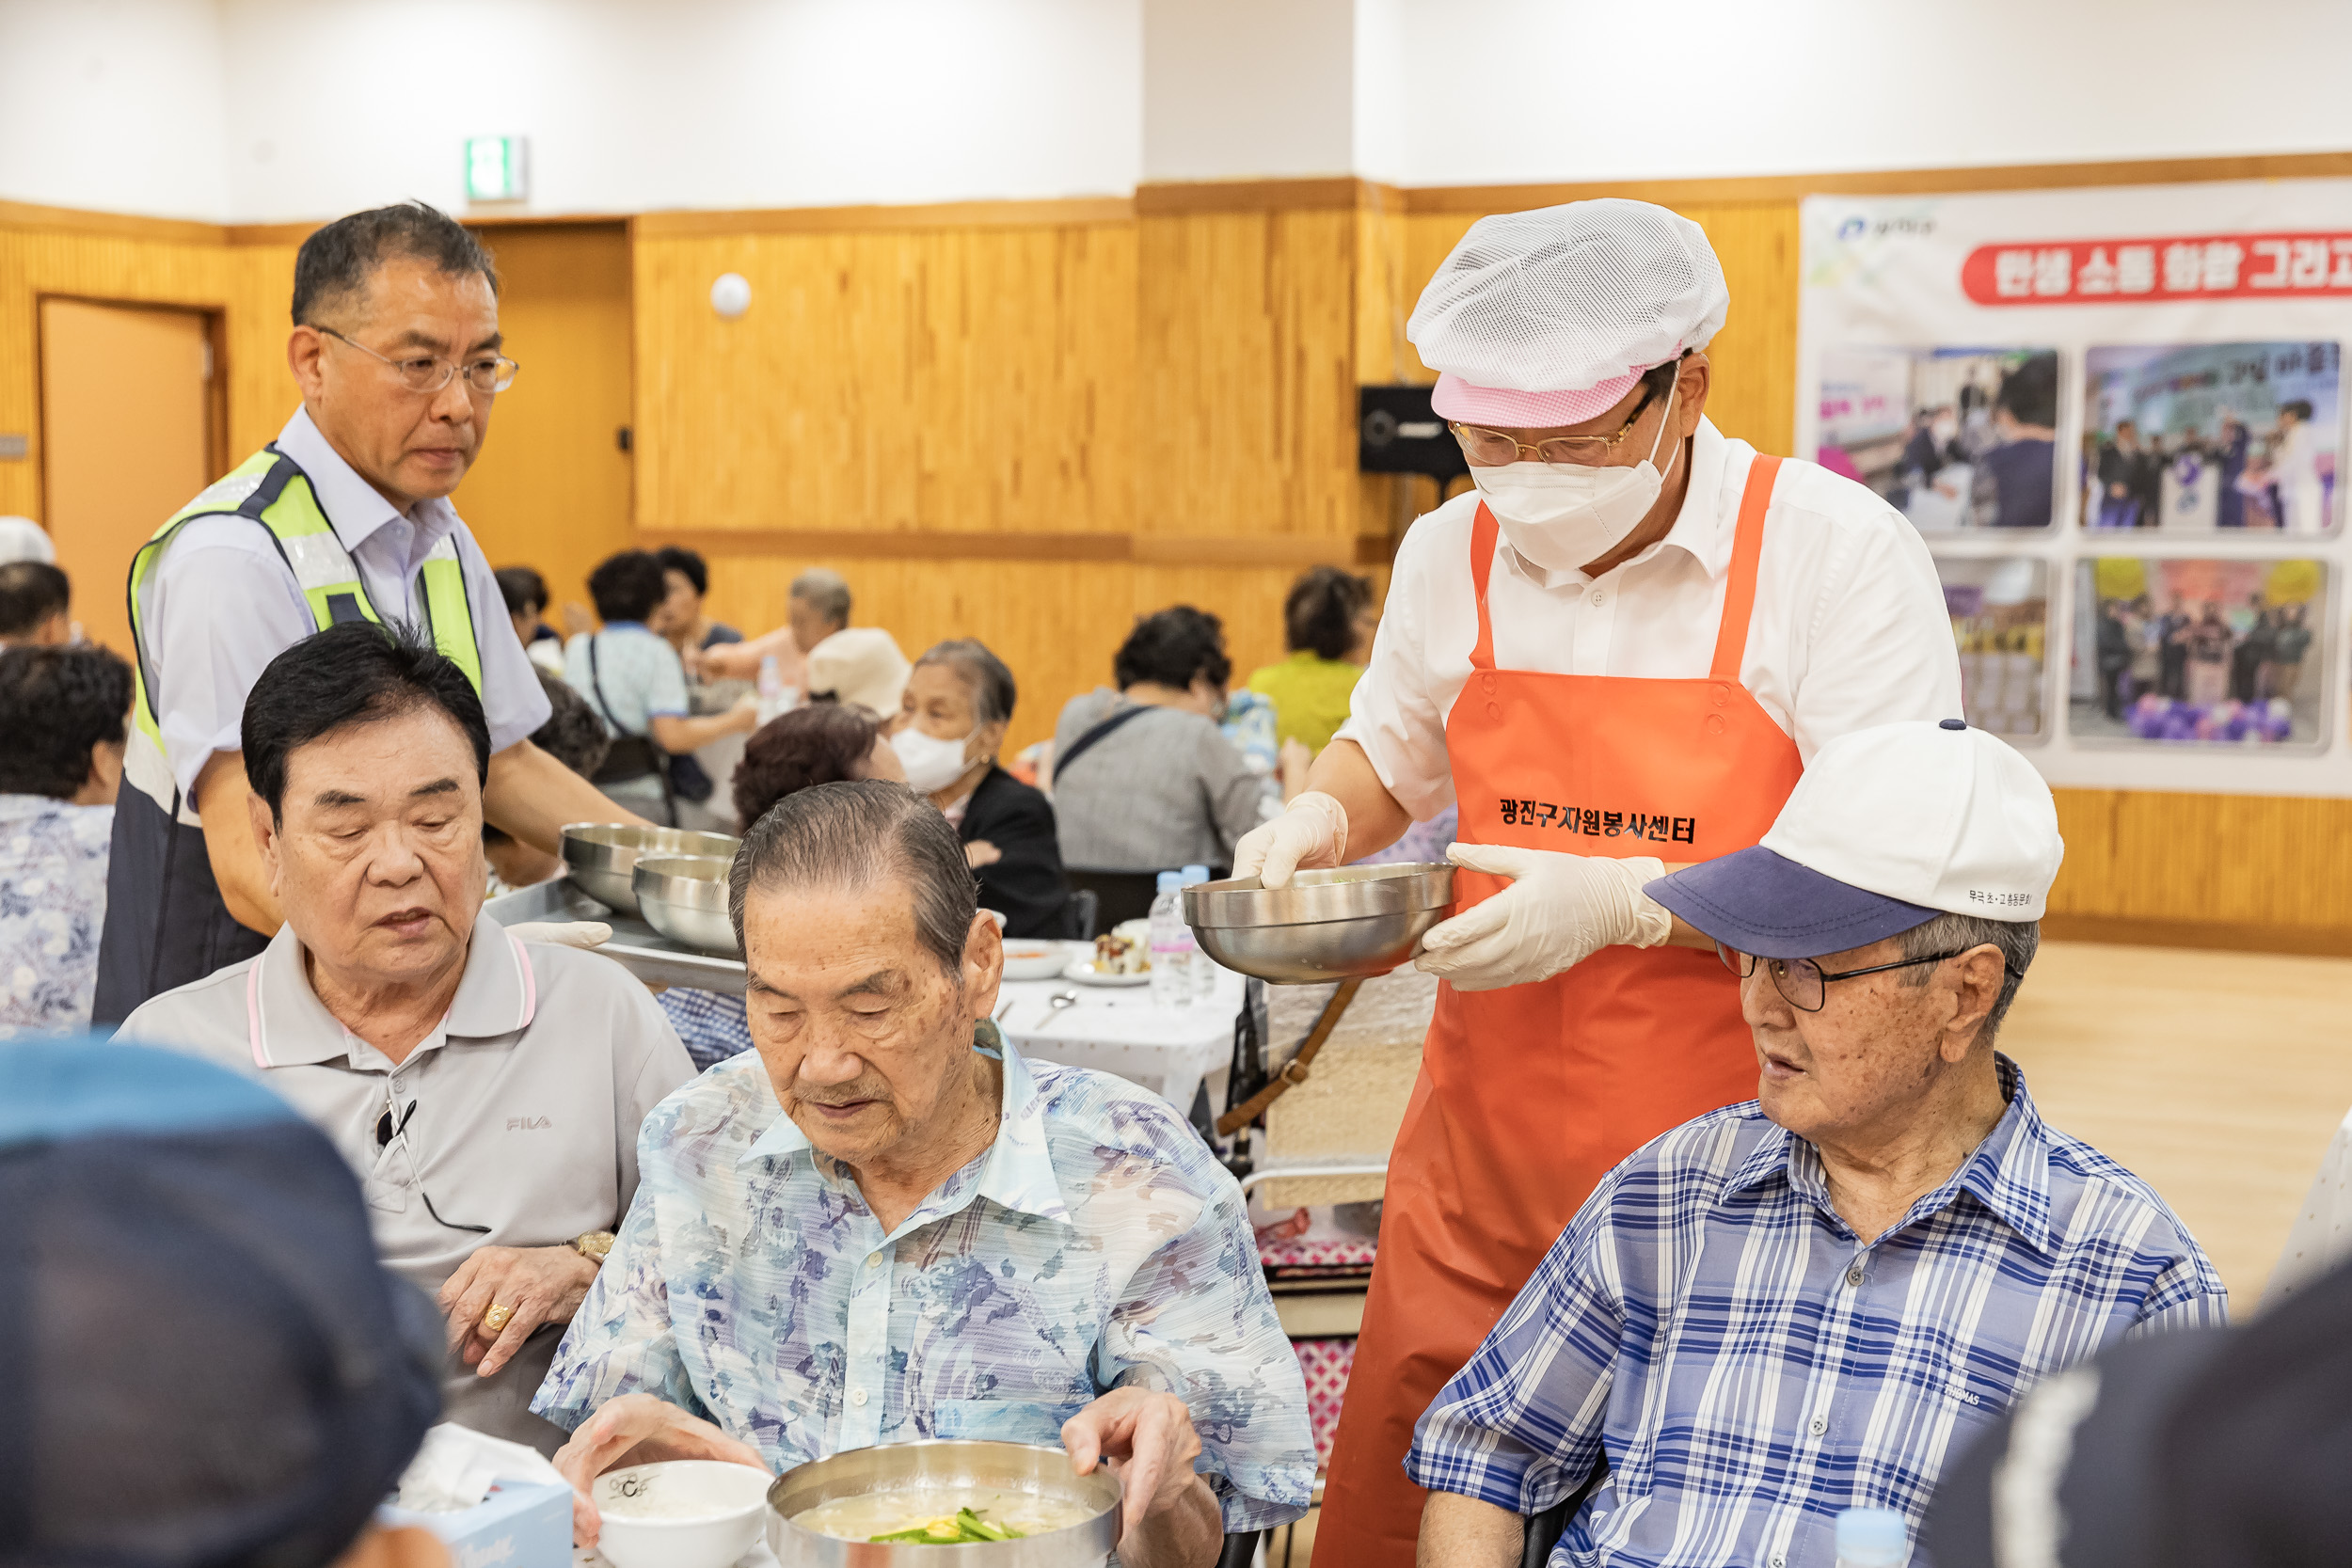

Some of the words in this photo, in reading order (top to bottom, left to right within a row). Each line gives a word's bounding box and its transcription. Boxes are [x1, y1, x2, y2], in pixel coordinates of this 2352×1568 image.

[2077, 245, 2155, 294] 소통
[506, 1116, 552, 1132] FILA
[1944, 1383, 1980, 1406] THOMAS
